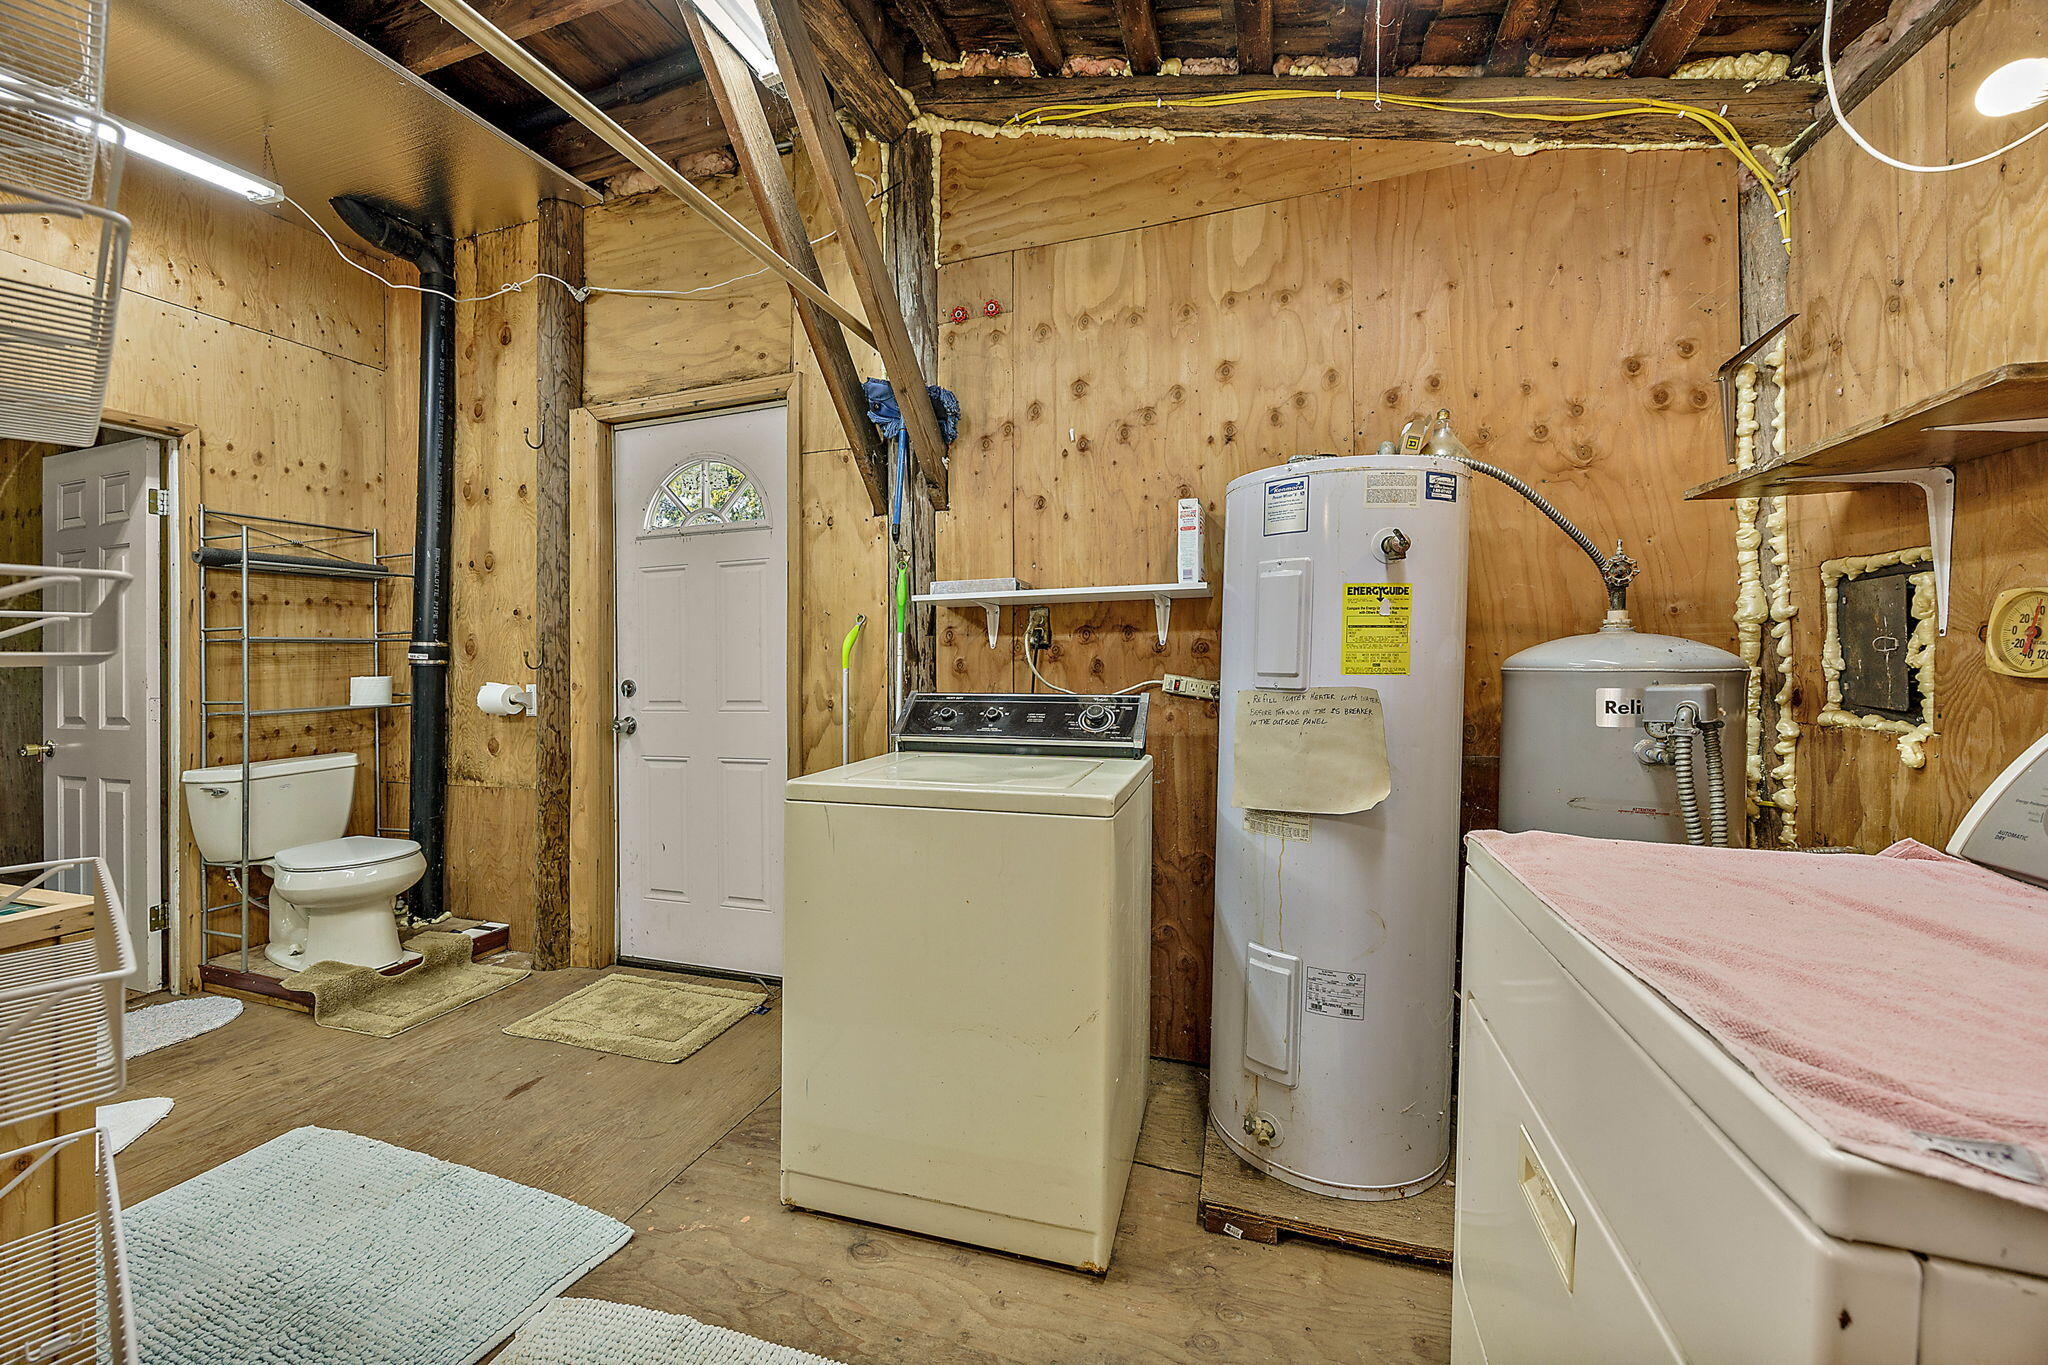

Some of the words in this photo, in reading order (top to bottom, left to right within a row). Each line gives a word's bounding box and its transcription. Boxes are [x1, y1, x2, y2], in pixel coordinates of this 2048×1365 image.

[1347, 586, 1410, 596] ENERGYGUIDE
[2019, 613, 2030, 624] 20
[2012, 625, 2018, 635] 0
[2011, 638, 2025, 648] -20
[1344, 708, 1374, 716] BREAKER
[1272, 718, 1300, 726] OUTSIDE
[1302, 718, 1328, 726] PANEL
[1998, 830, 2029, 841] AUTOMATIC
